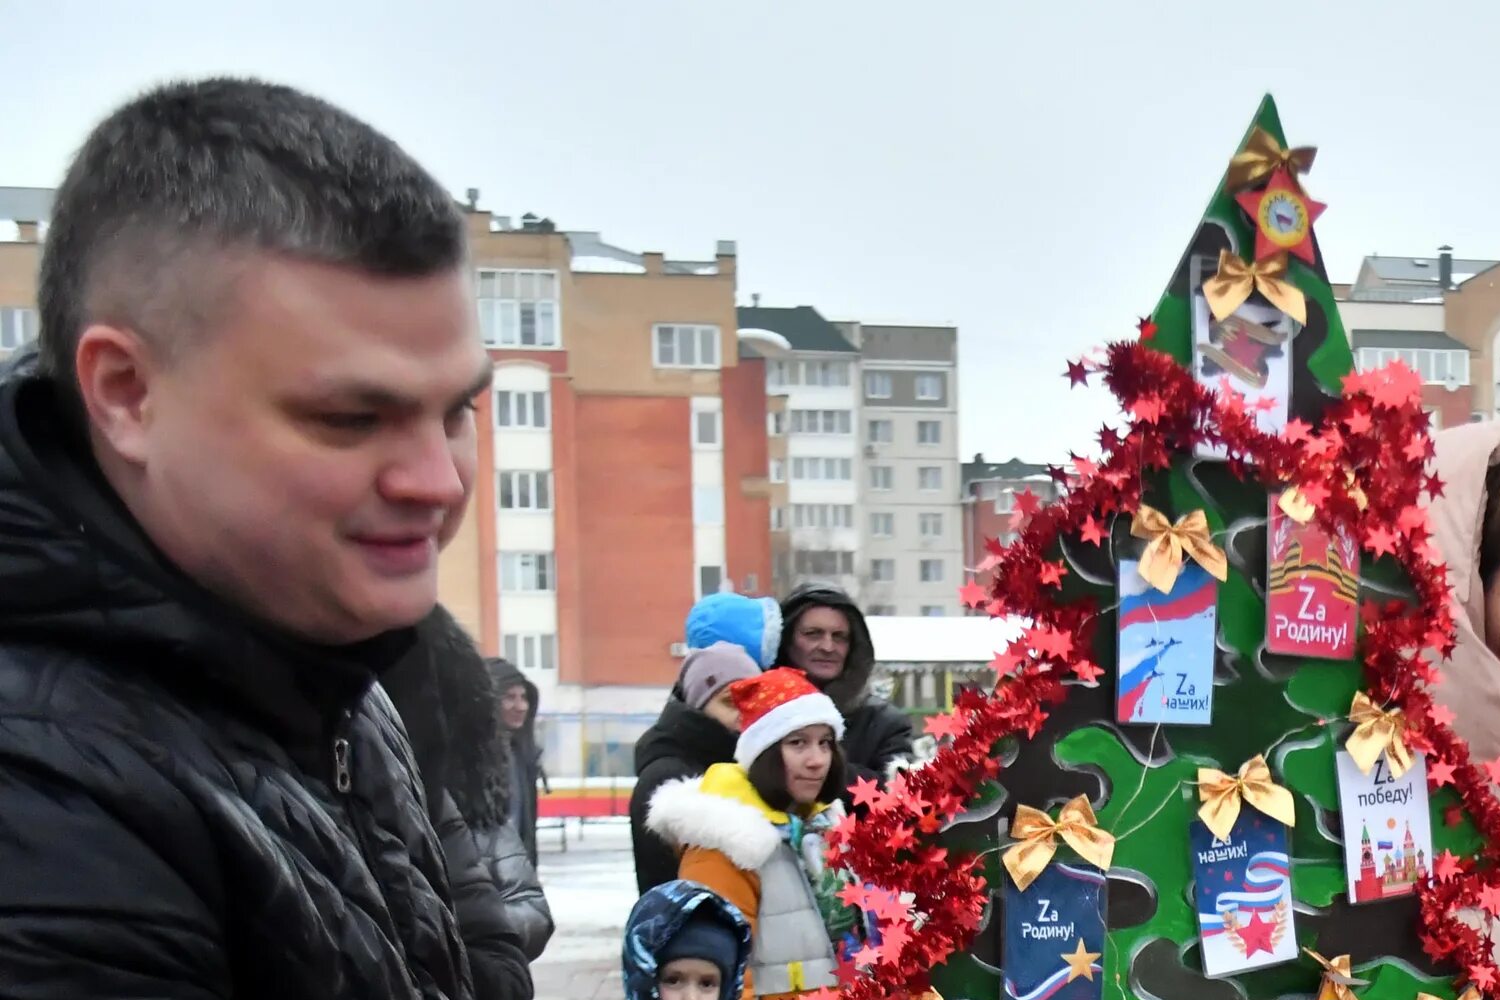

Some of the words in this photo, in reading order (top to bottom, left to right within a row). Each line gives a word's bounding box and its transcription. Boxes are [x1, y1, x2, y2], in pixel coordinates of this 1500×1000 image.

[1275, 614, 1347, 650] Родину!
[1358, 783, 1413, 806] победу!
[1199, 840, 1247, 864] наших!
[1022, 922, 1074, 940] Родину!
